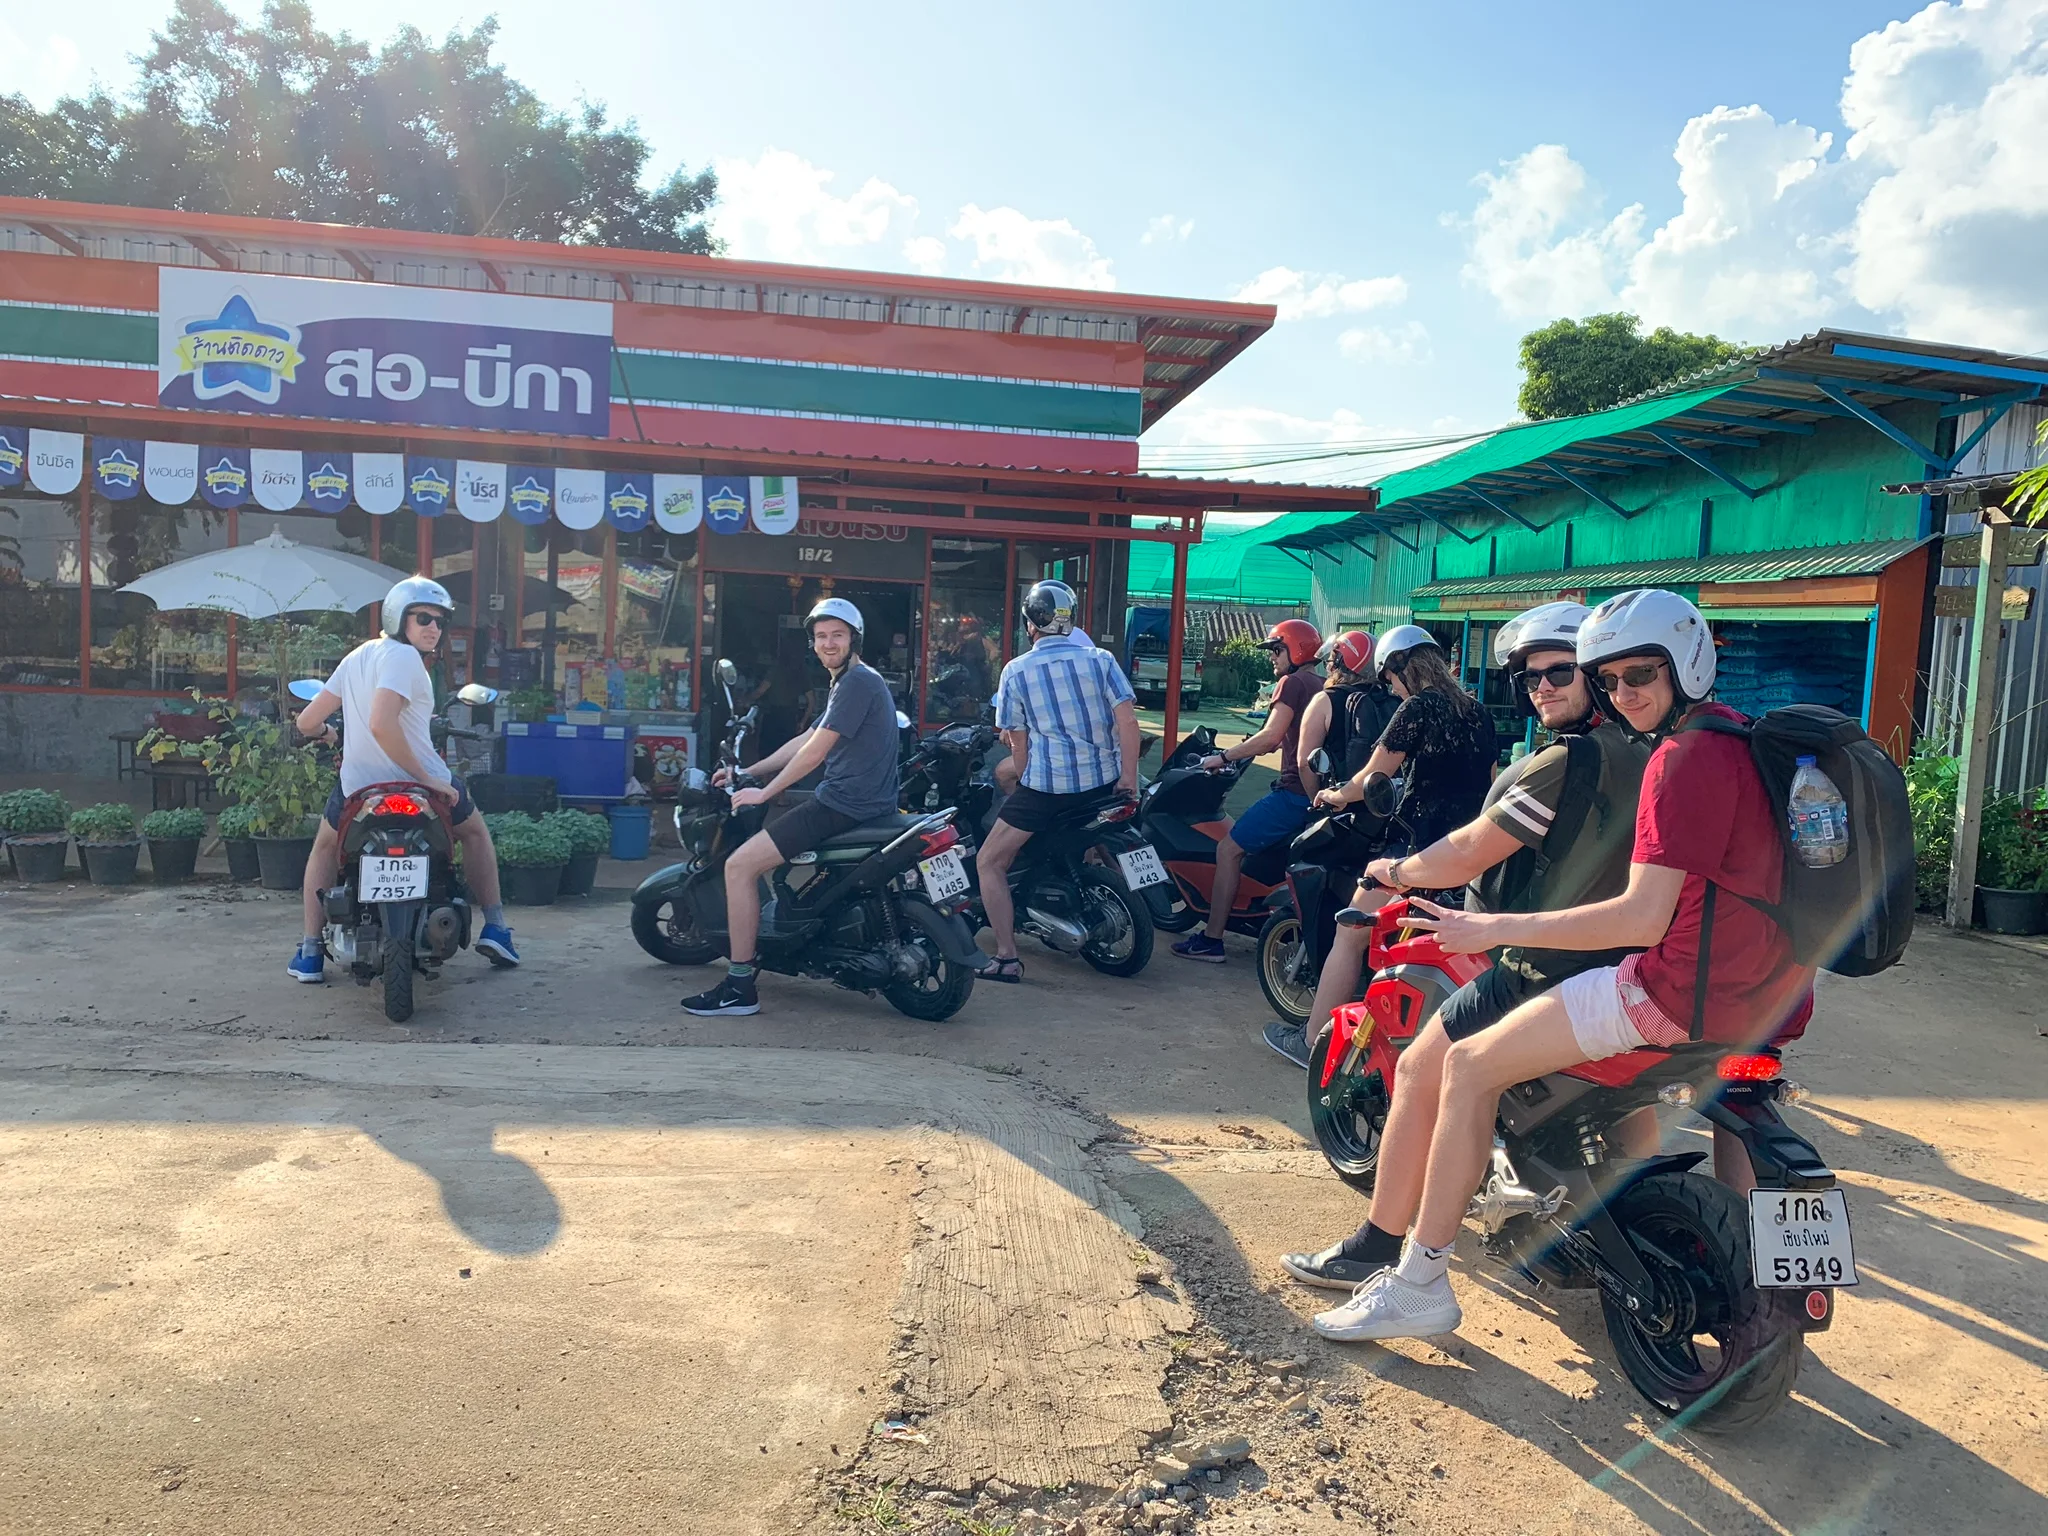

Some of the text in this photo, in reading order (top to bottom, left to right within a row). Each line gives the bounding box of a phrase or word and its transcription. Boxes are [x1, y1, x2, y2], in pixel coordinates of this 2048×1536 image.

[191, 336, 285, 364] ร้านติดดาว
[324, 343, 592, 415] สอ-บีกา
[798, 547, 833, 563] 18/2
[937, 877, 964, 898] 1485
[1139, 872, 1160, 886] 443
[370, 885, 417, 899] 7357
[1778, 1197, 1826, 1222] 1กล
[1782, 1228, 1830, 1247] เชียงใหม่
[1773, 1256, 1843, 1283] 5349
